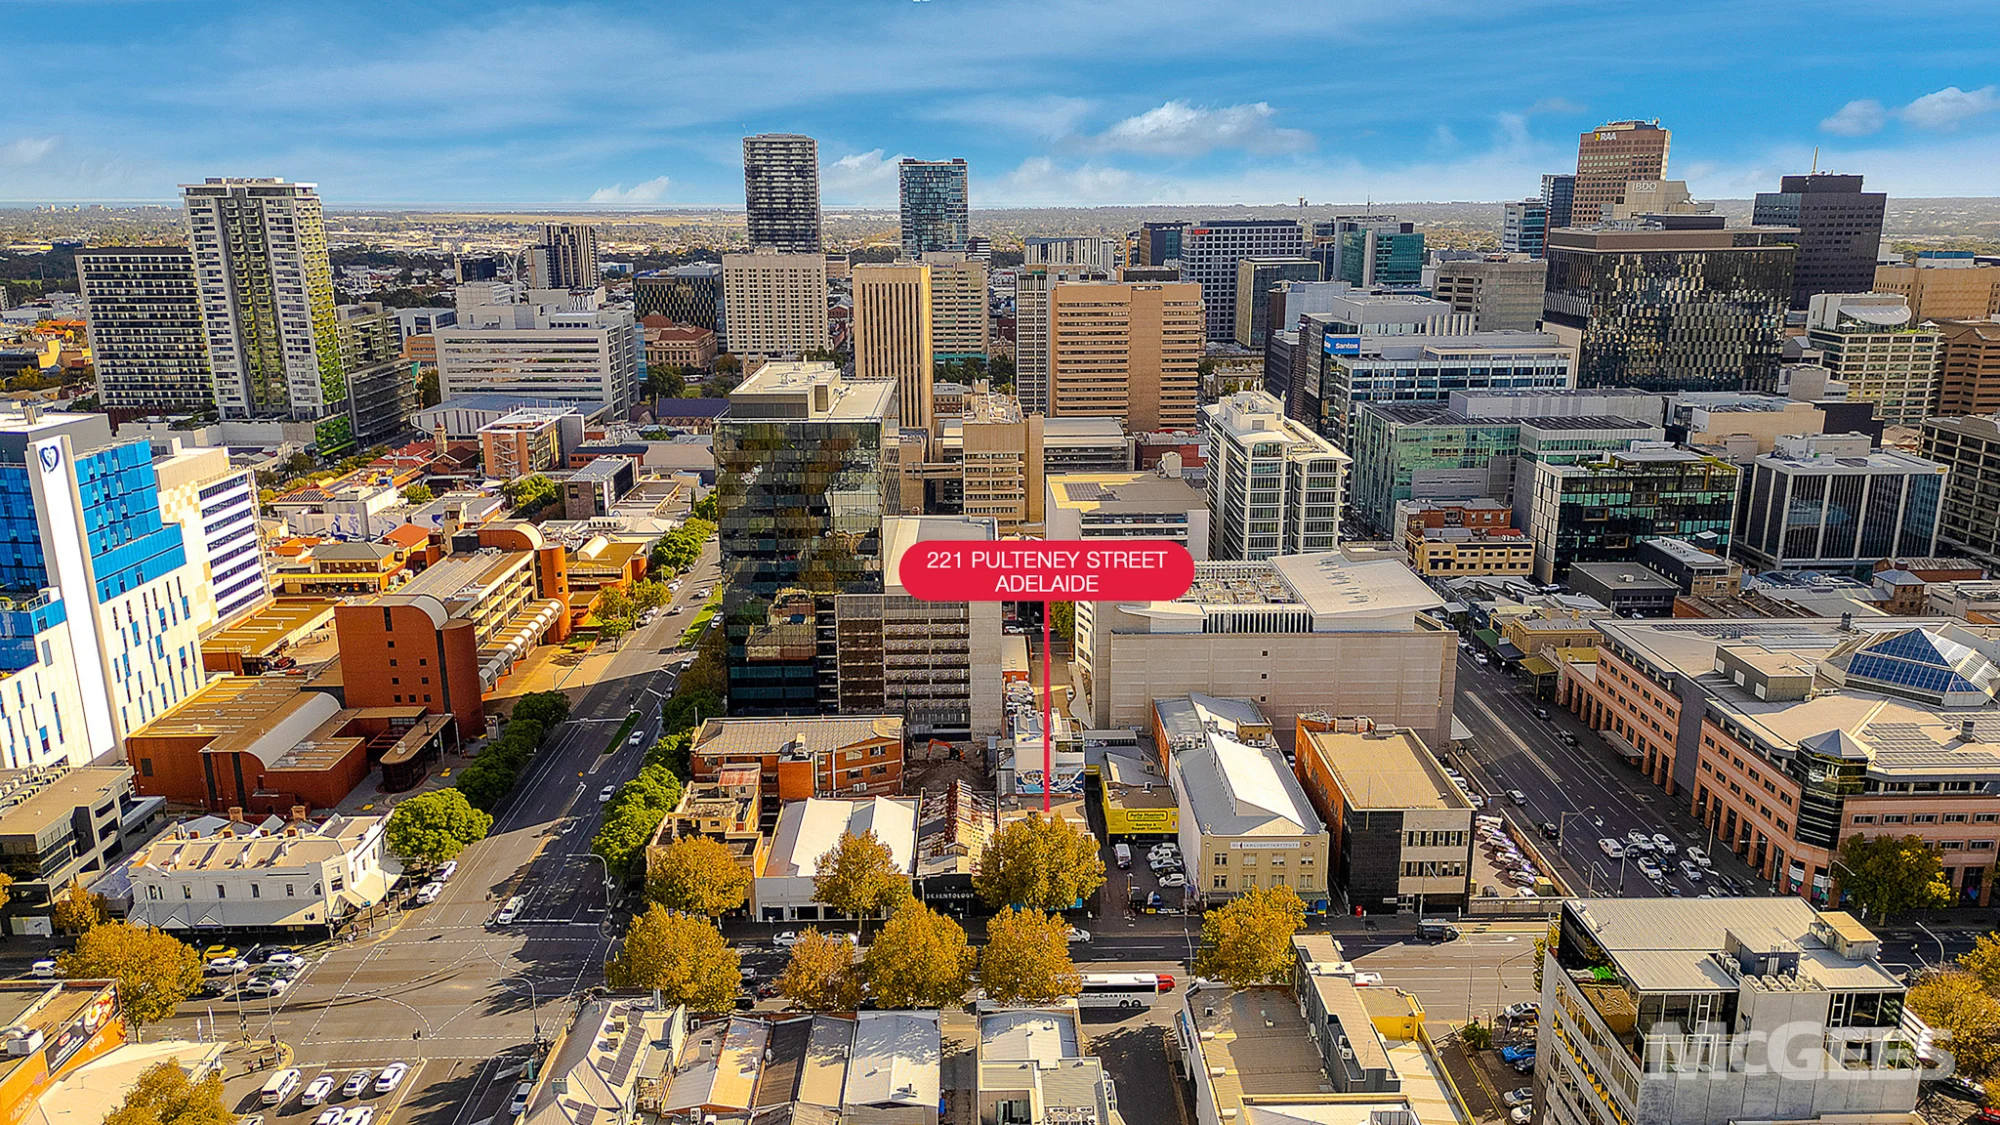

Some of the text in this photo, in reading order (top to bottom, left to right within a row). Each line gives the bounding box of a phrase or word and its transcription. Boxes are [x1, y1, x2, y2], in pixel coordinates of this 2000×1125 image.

[1600, 132, 1617, 141] RAA
[1635, 182, 1657, 190] BDO
[1335, 342, 1359, 350] Santos
